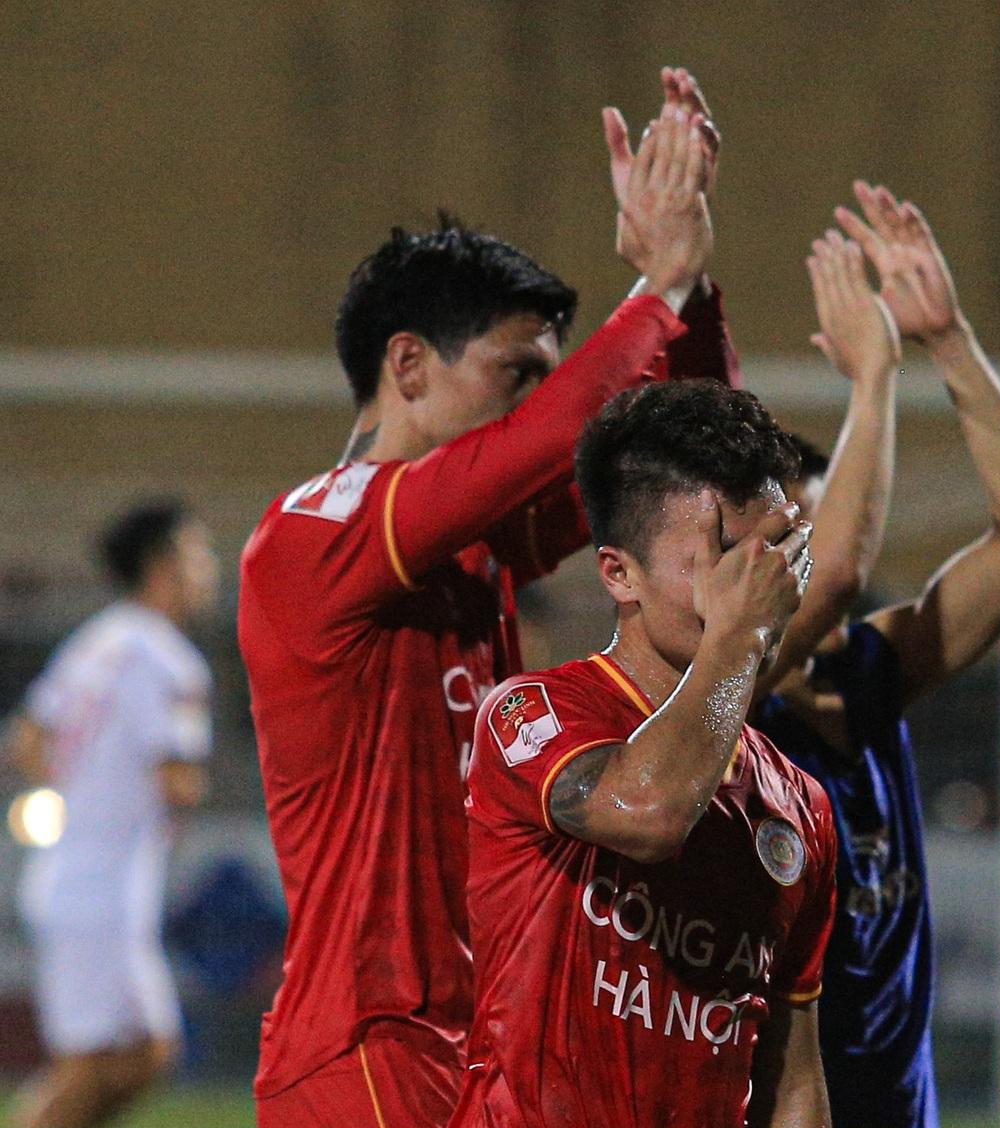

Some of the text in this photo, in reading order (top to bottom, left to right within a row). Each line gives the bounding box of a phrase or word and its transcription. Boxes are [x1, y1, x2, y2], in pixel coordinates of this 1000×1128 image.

[582, 875, 777, 980] CÔNG AN
[592, 959, 746, 1056] HÀ NỘI
